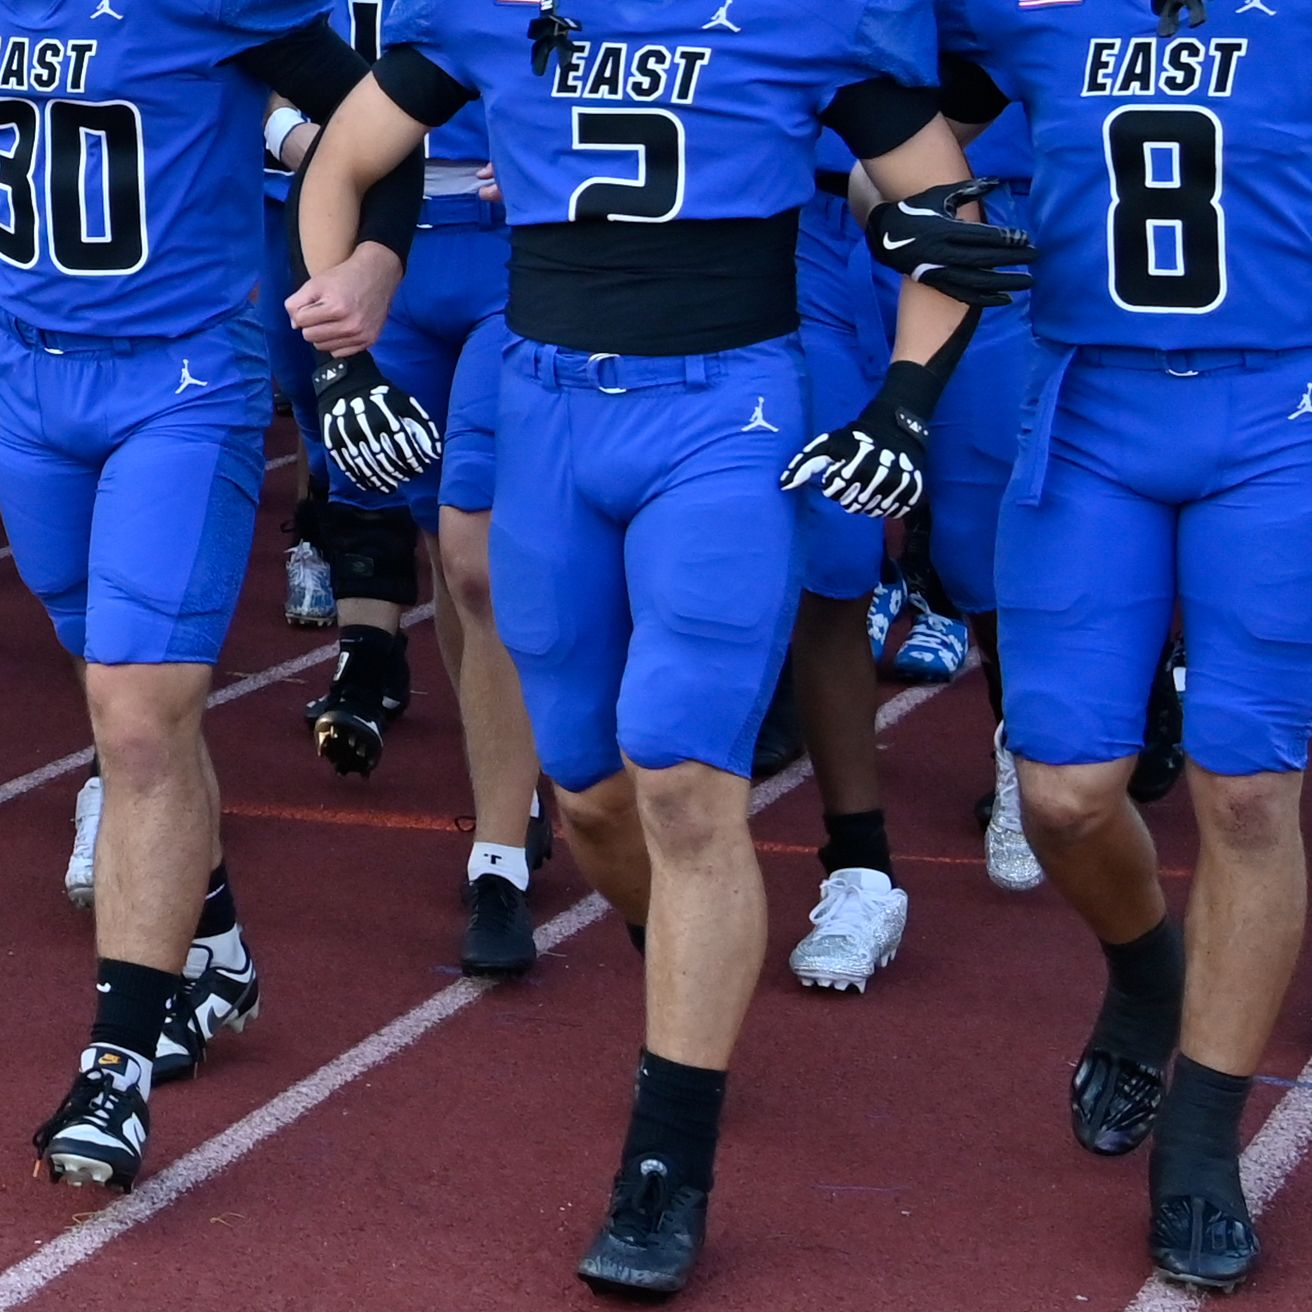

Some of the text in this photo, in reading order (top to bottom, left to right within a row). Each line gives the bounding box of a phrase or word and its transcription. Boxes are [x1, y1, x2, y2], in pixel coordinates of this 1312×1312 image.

[550, 41, 711, 105] EAST
[1080, 36, 1249, 98] EAST
[567, 107, 686, 224] 2
[1101, 103, 1227, 315] 8
